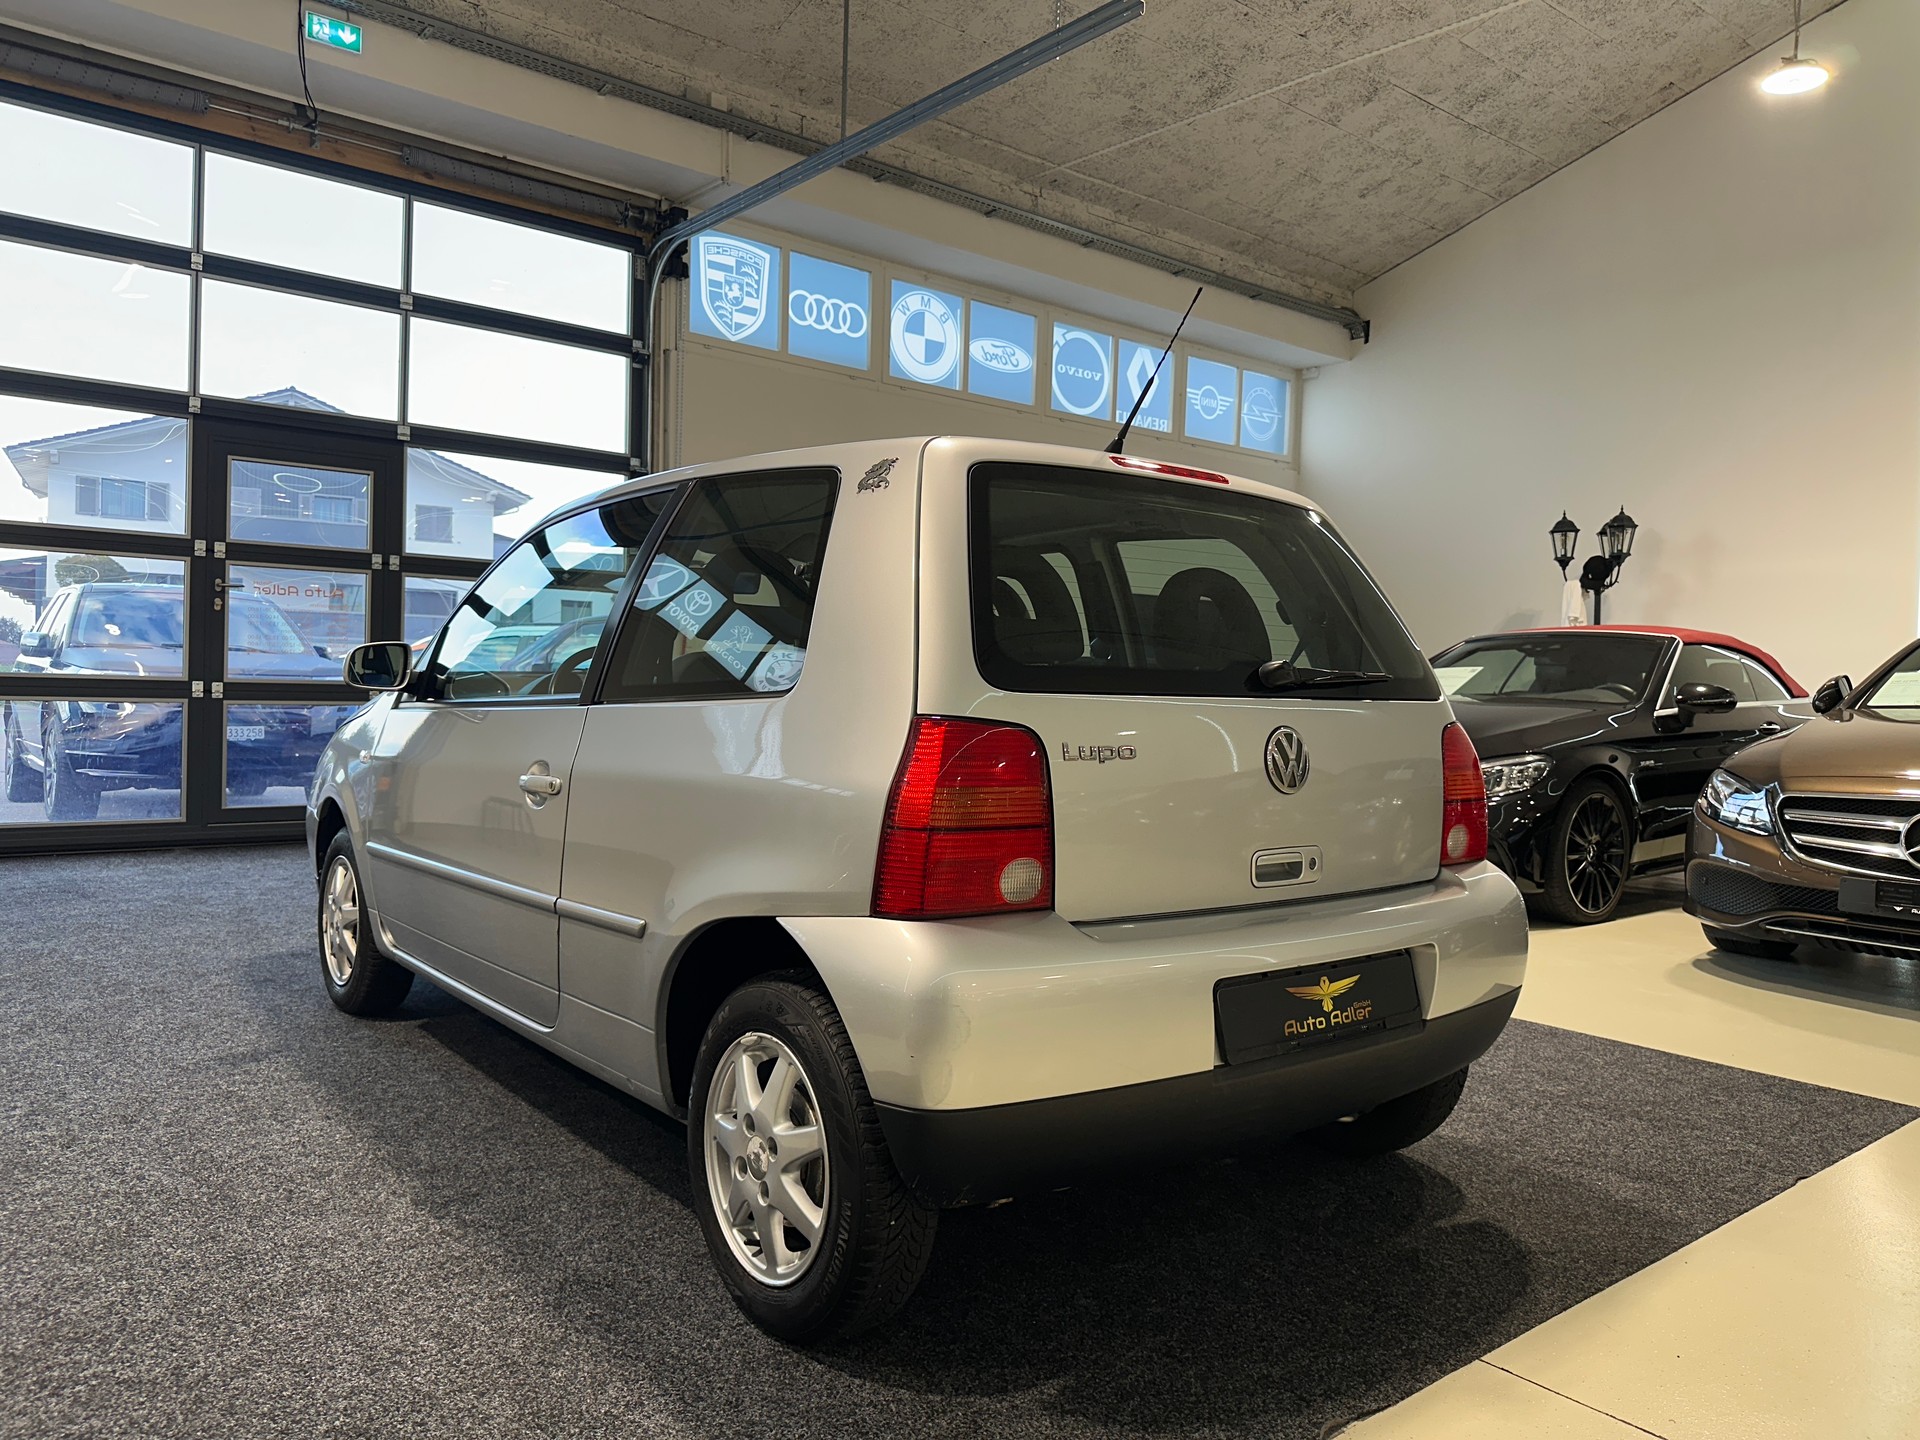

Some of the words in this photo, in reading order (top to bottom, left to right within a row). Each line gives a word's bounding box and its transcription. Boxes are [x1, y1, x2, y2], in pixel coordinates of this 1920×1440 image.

[665, 603, 700, 634] TOYOTA
[707, 640, 747, 674] PEUGEOT
[1062, 742, 1137, 764] Lupo
[1353, 999, 1371, 1009] GmbH
[1284, 1016, 1326, 1036] Auto
[1330, 1006, 1372, 1026] Adler
